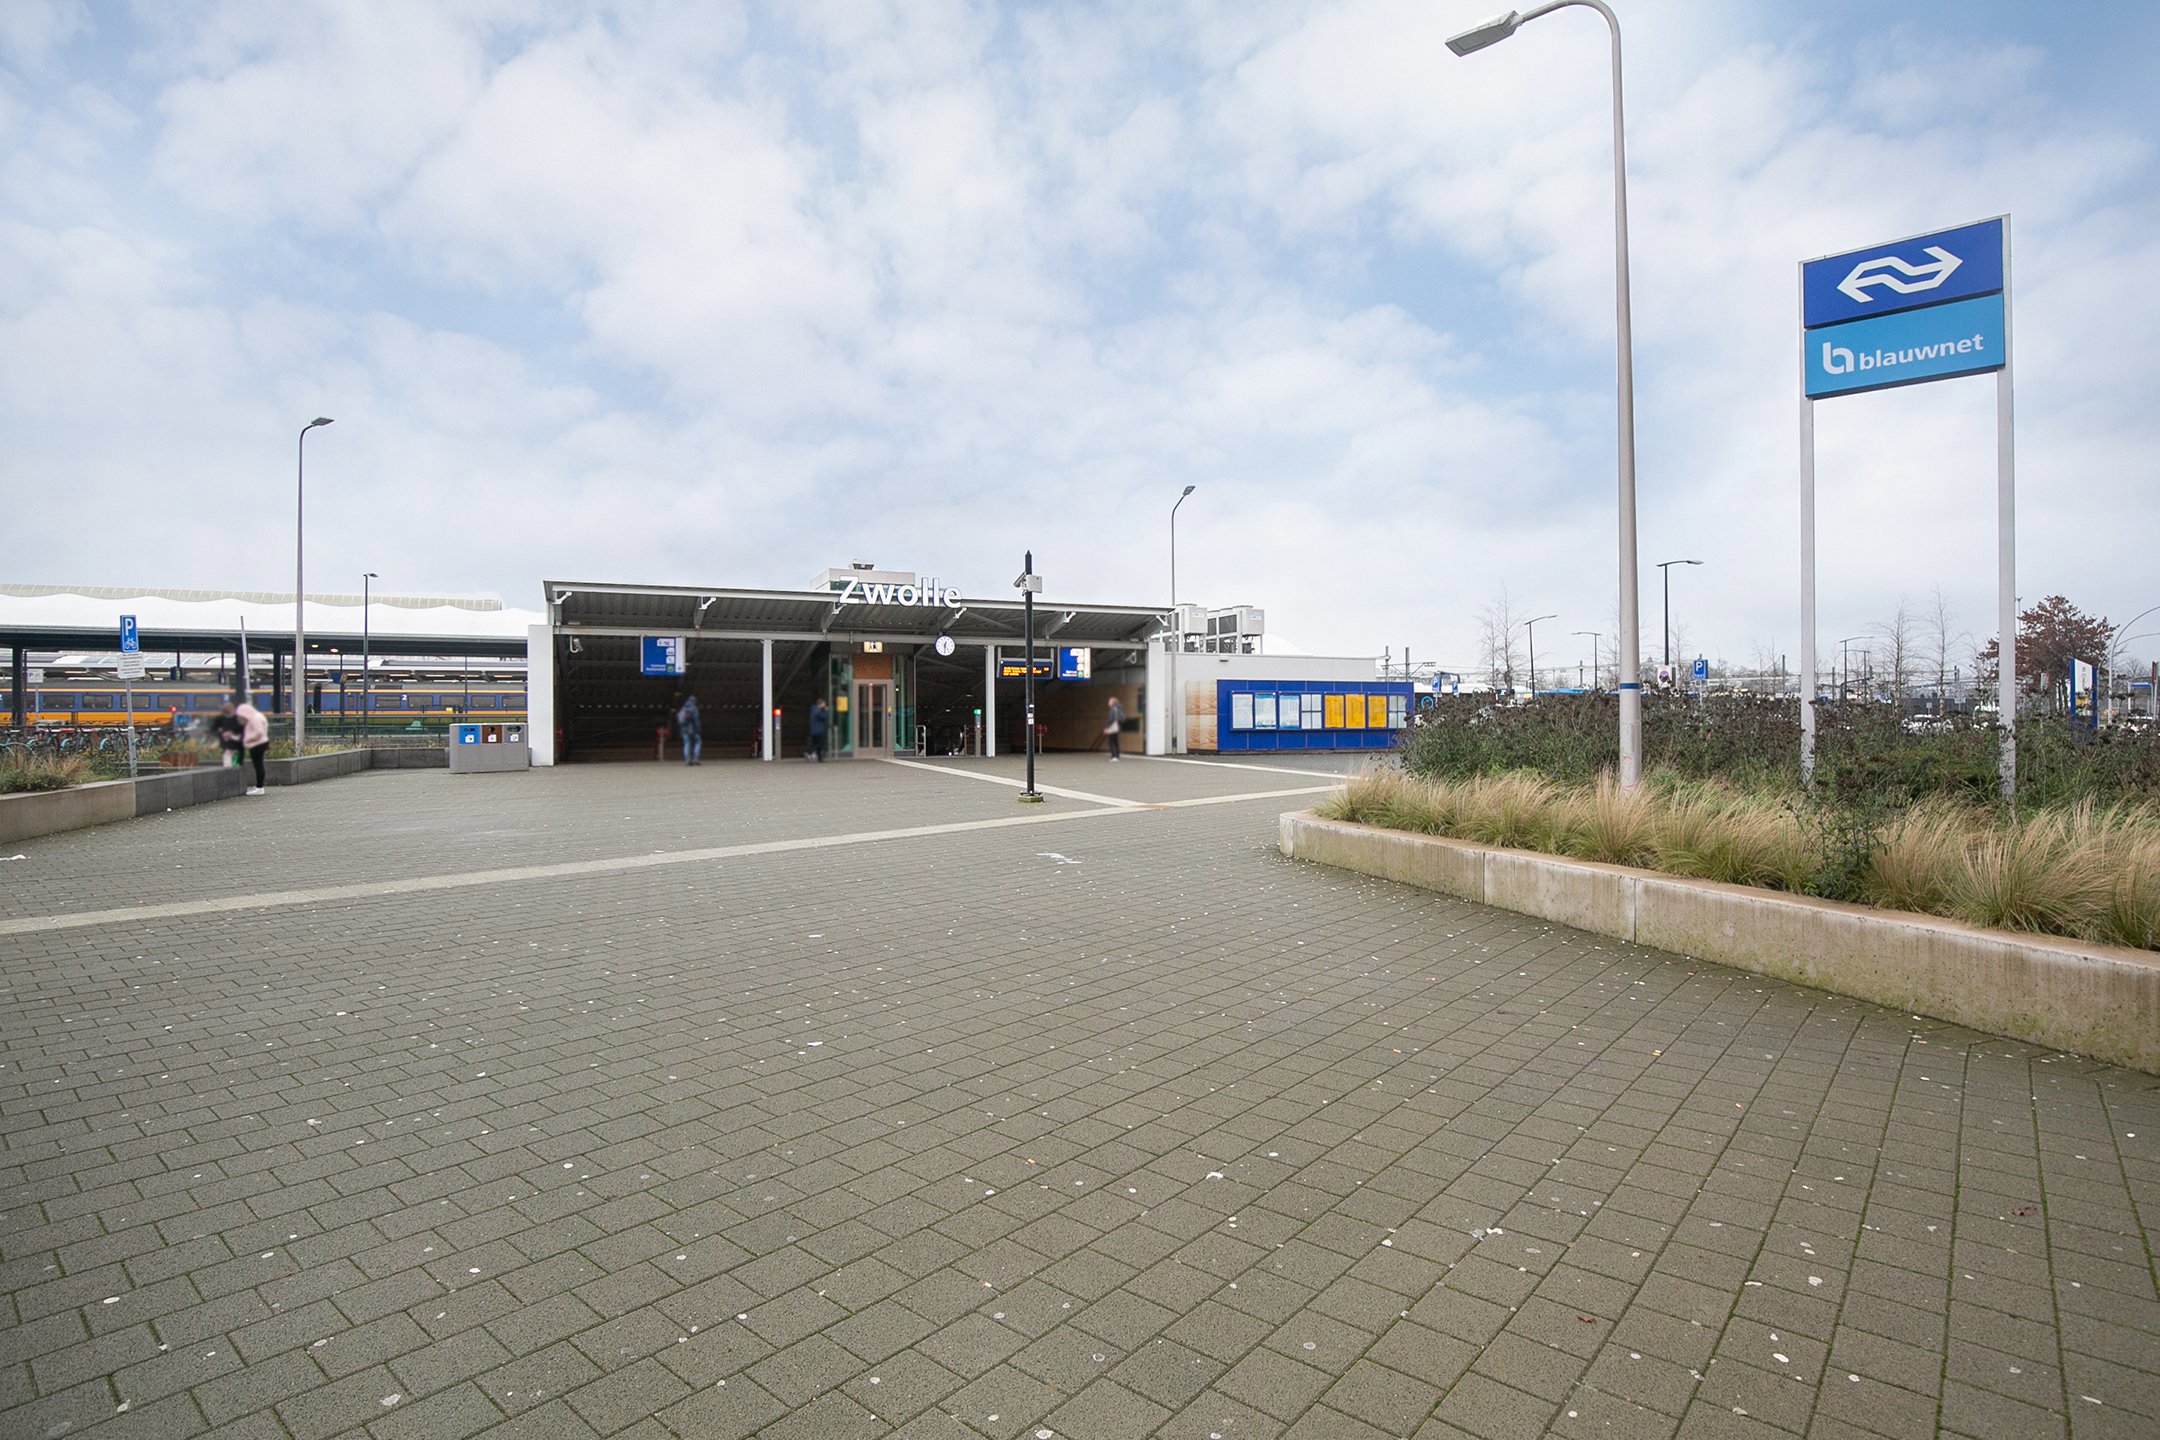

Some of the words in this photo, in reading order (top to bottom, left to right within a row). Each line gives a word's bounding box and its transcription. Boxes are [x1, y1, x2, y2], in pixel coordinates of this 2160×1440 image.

[1860, 333, 1984, 370] blauwnet
[839, 575, 961, 608] Zwolle
[125, 618, 134, 636] P
[1695, 661, 1703, 672] P
